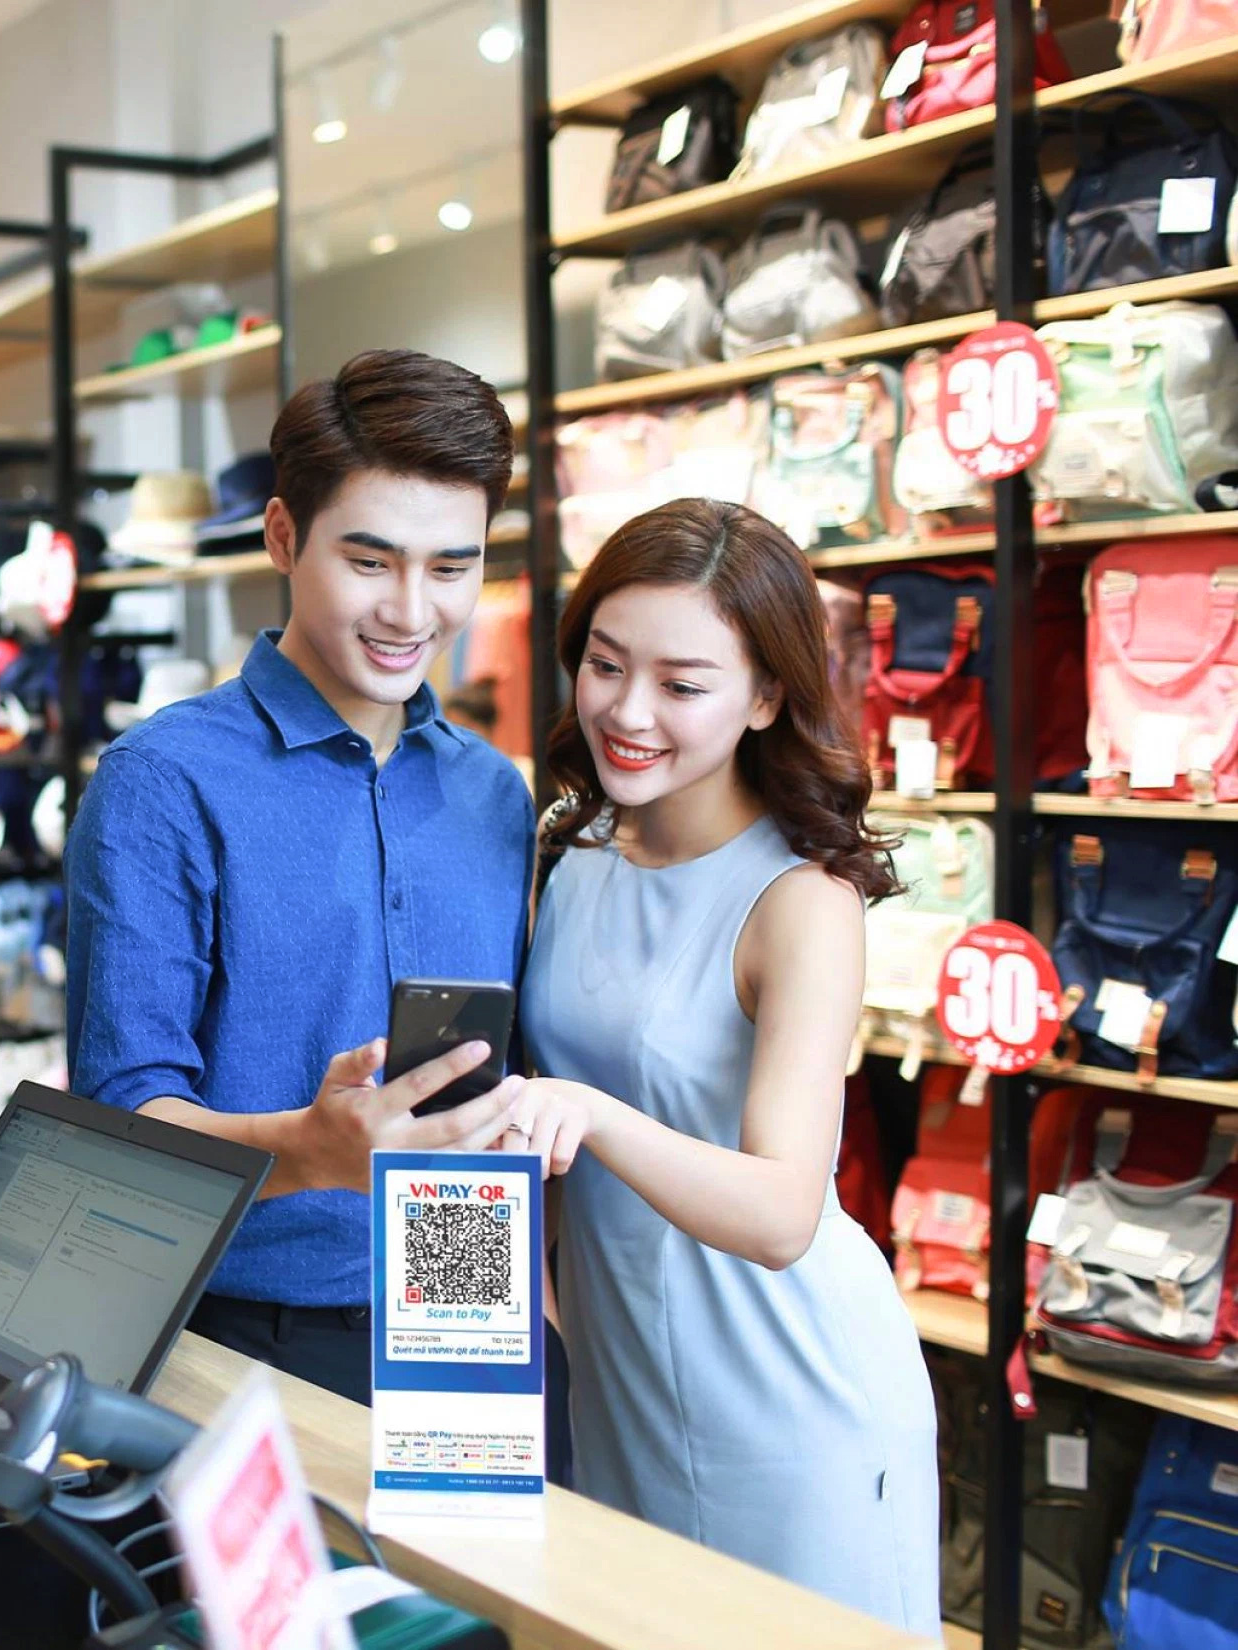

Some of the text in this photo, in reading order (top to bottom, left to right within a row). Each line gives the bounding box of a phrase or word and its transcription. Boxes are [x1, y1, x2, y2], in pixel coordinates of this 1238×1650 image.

[410, 1183, 505, 1202] VNPAY-QR
[426, 1308, 492, 1322] Scan to Pay
[504, 1337, 524, 1345] 12345
[427, 1346, 468, 1356] VNPAY-QR
[481, 1347, 504, 1356] thanh
[439, 1431, 453, 1440] Pay
